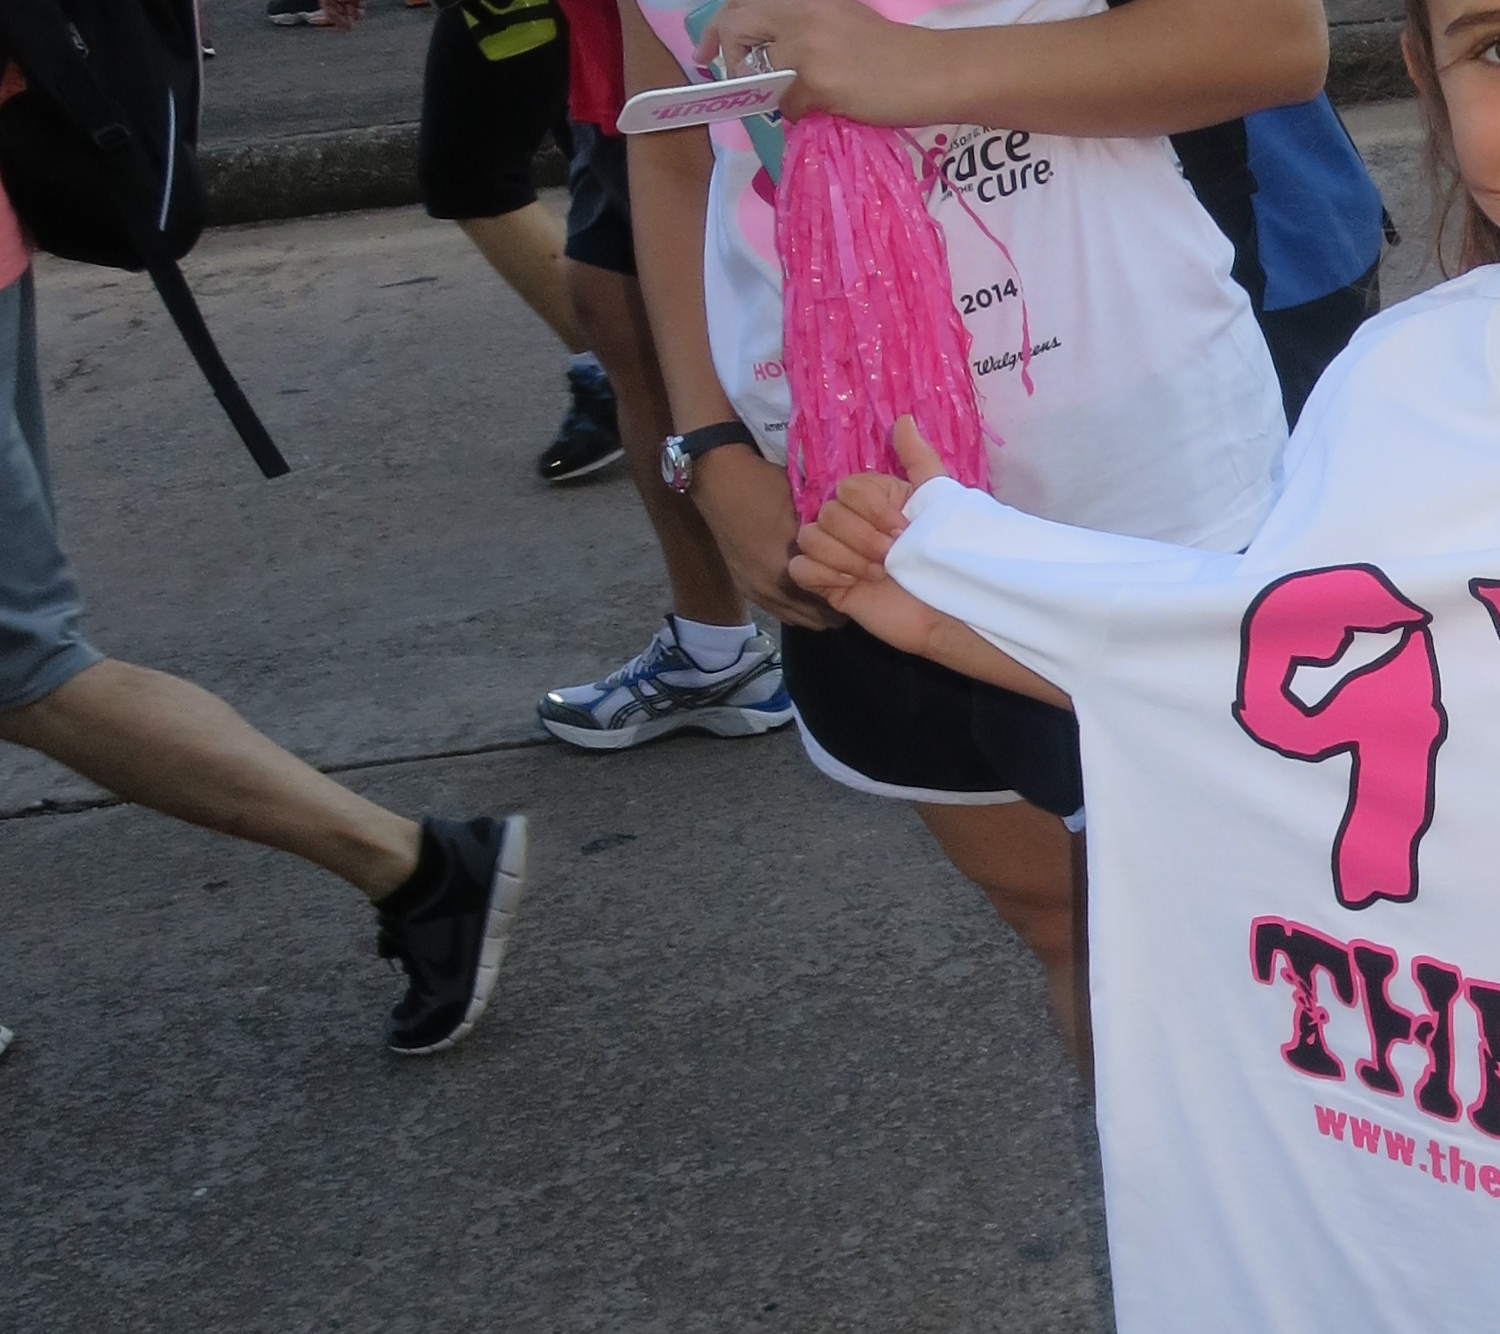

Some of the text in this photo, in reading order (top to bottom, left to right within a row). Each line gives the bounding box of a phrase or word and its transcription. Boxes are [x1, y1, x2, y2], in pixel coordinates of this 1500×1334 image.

[939, 130, 1031, 195] race
[960, 278, 1018, 315] 2014
[973, 336, 1062, 377] Walgrens
